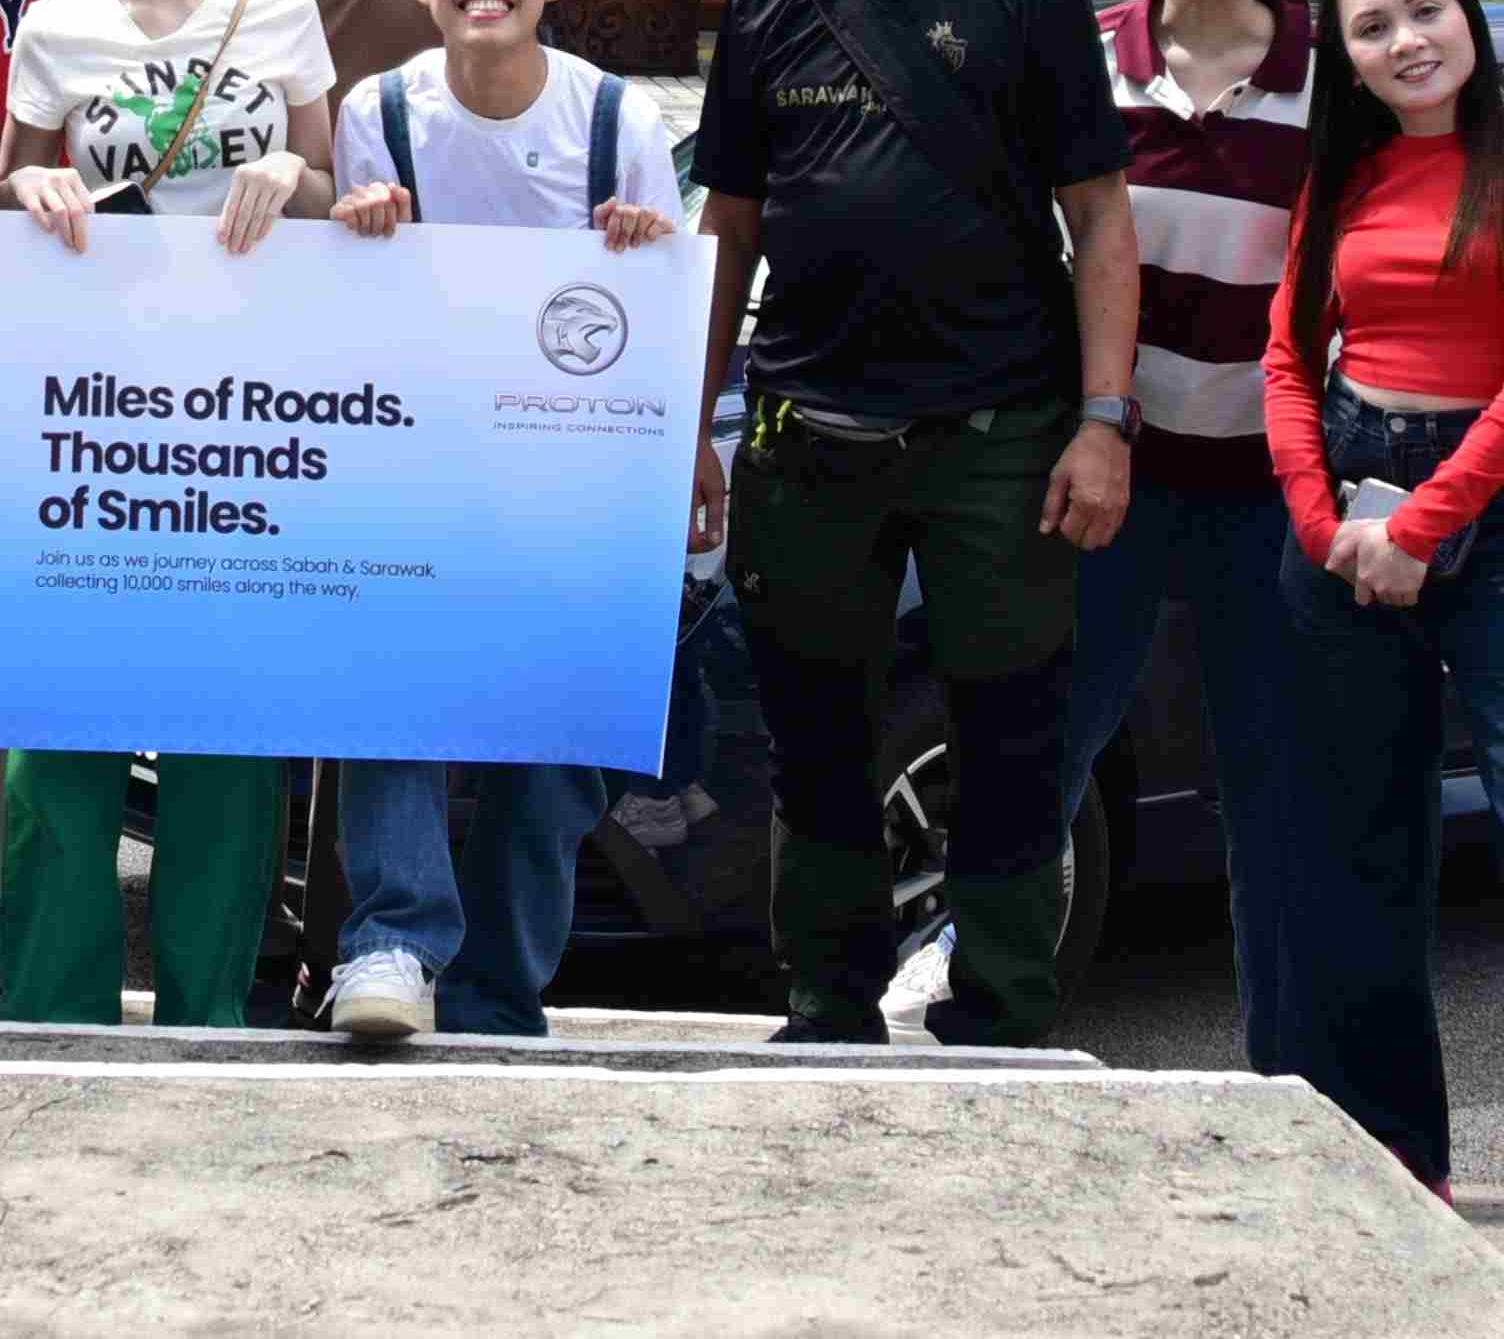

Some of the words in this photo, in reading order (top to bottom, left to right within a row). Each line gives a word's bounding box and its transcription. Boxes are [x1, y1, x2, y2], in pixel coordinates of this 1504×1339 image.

[43, 373, 174, 420] Miles
[183, 377, 234, 420] of
[242, 381, 416, 428] Roads.
[495, 395, 666, 418] PROTON
[493, 421, 562, 433] INSPIRING
[567, 424, 666, 437] CONNECTIONS
[42, 432, 328, 481] Thousands
[39, 486, 89, 530] of
[97, 488, 280, 536] Smiles.
[35, 550, 71, 567] Join
[75, 554, 95, 567] us
[99, 555, 121, 568] as
[124, 556, 150, 568] we
[153, 554, 217, 573] journey
[221, 557, 279, 572] across
[282, 557, 339, 574] Sabah
[342, 560, 355, 575] &
[35, 574, 119, 595] collecting
[123, 575, 174, 593] 10,000
[177, 577, 232, 594] smiles
[235, 579, 285, 600] along
[289, 580, 318, 597] the
